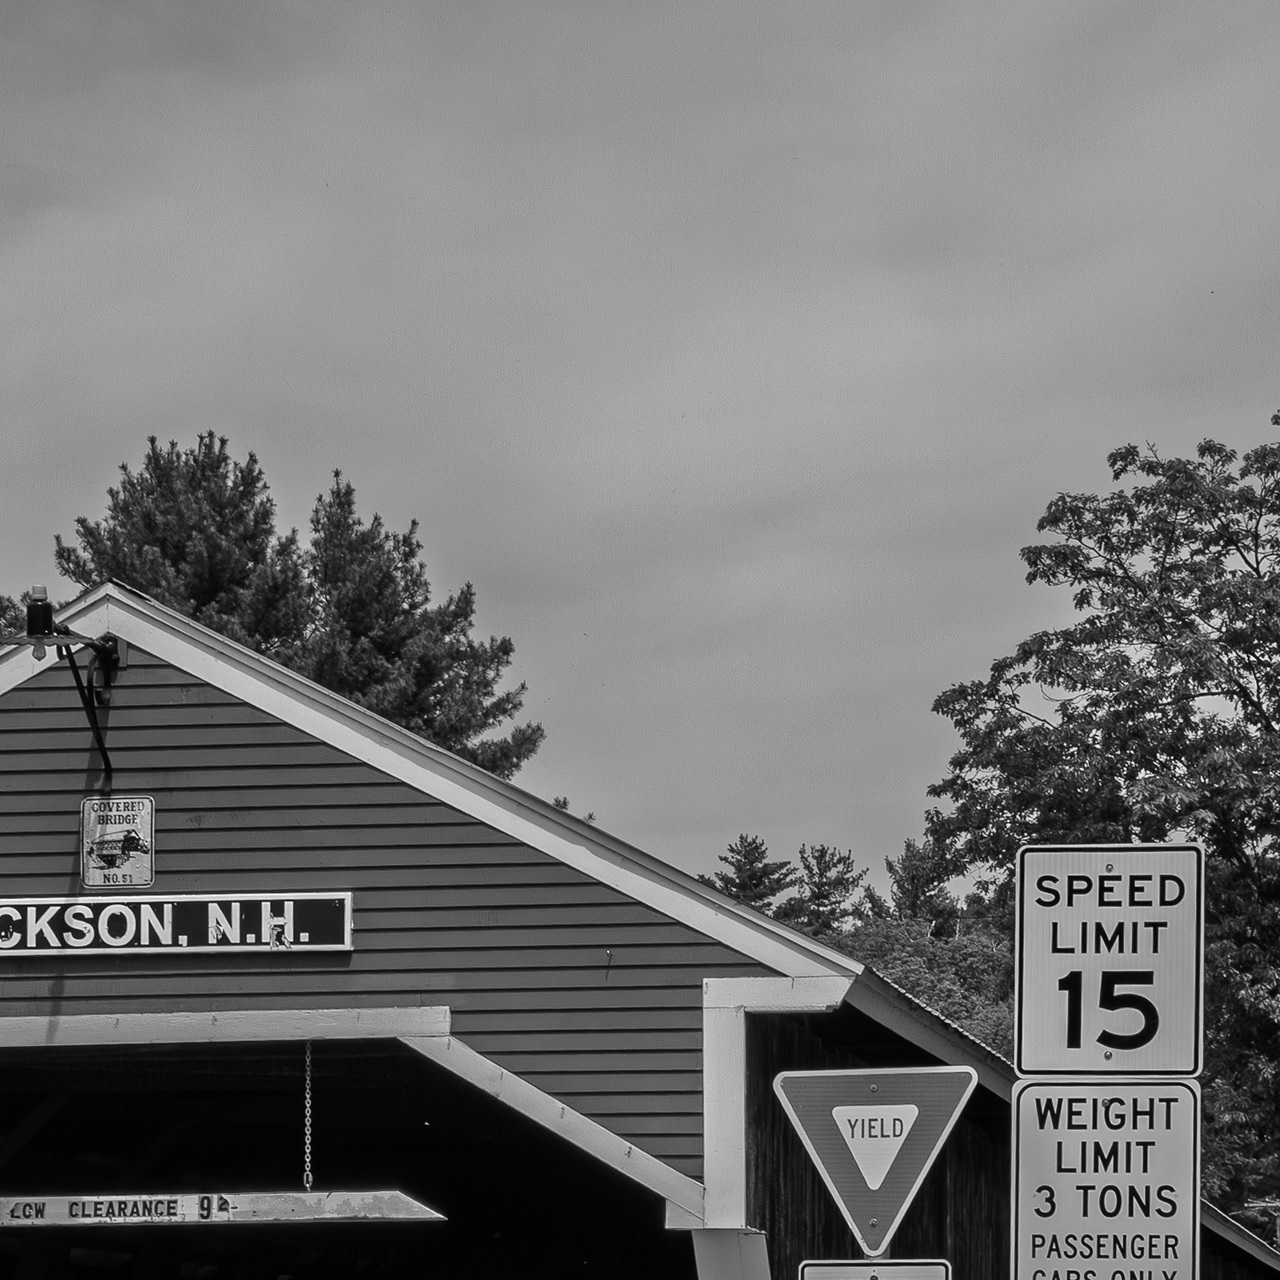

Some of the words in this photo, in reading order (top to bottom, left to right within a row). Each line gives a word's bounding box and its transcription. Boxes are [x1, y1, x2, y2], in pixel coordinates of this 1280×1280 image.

[91, 801, 145, 813] COVERED
[97, 814, 139, 825] BRIDGE
[122, 874, 133, 883] 51
[1035, 875, 1186, 907] SPEED
[208, 900, 310, 944] N.H.
[1051, 921, 1168, 954] LIMIT
[1057, 970, 1160, 1050] 15
[847, 1118, 904, 1138] YIELD
[1035, 1097, 1179, 1130] WEIGHT
[1056, 1141, 1156, 1173] LIMIT
[10, 1202, 46, 1219] LOW
[69, 1200, 178, 1218] CLEARANCE
[1033, 1185, 1056, 1218] 3
[1075, 1185, 1178, 1218] TONS
[1031, 1234, 1179, 1260] PASSENGER
